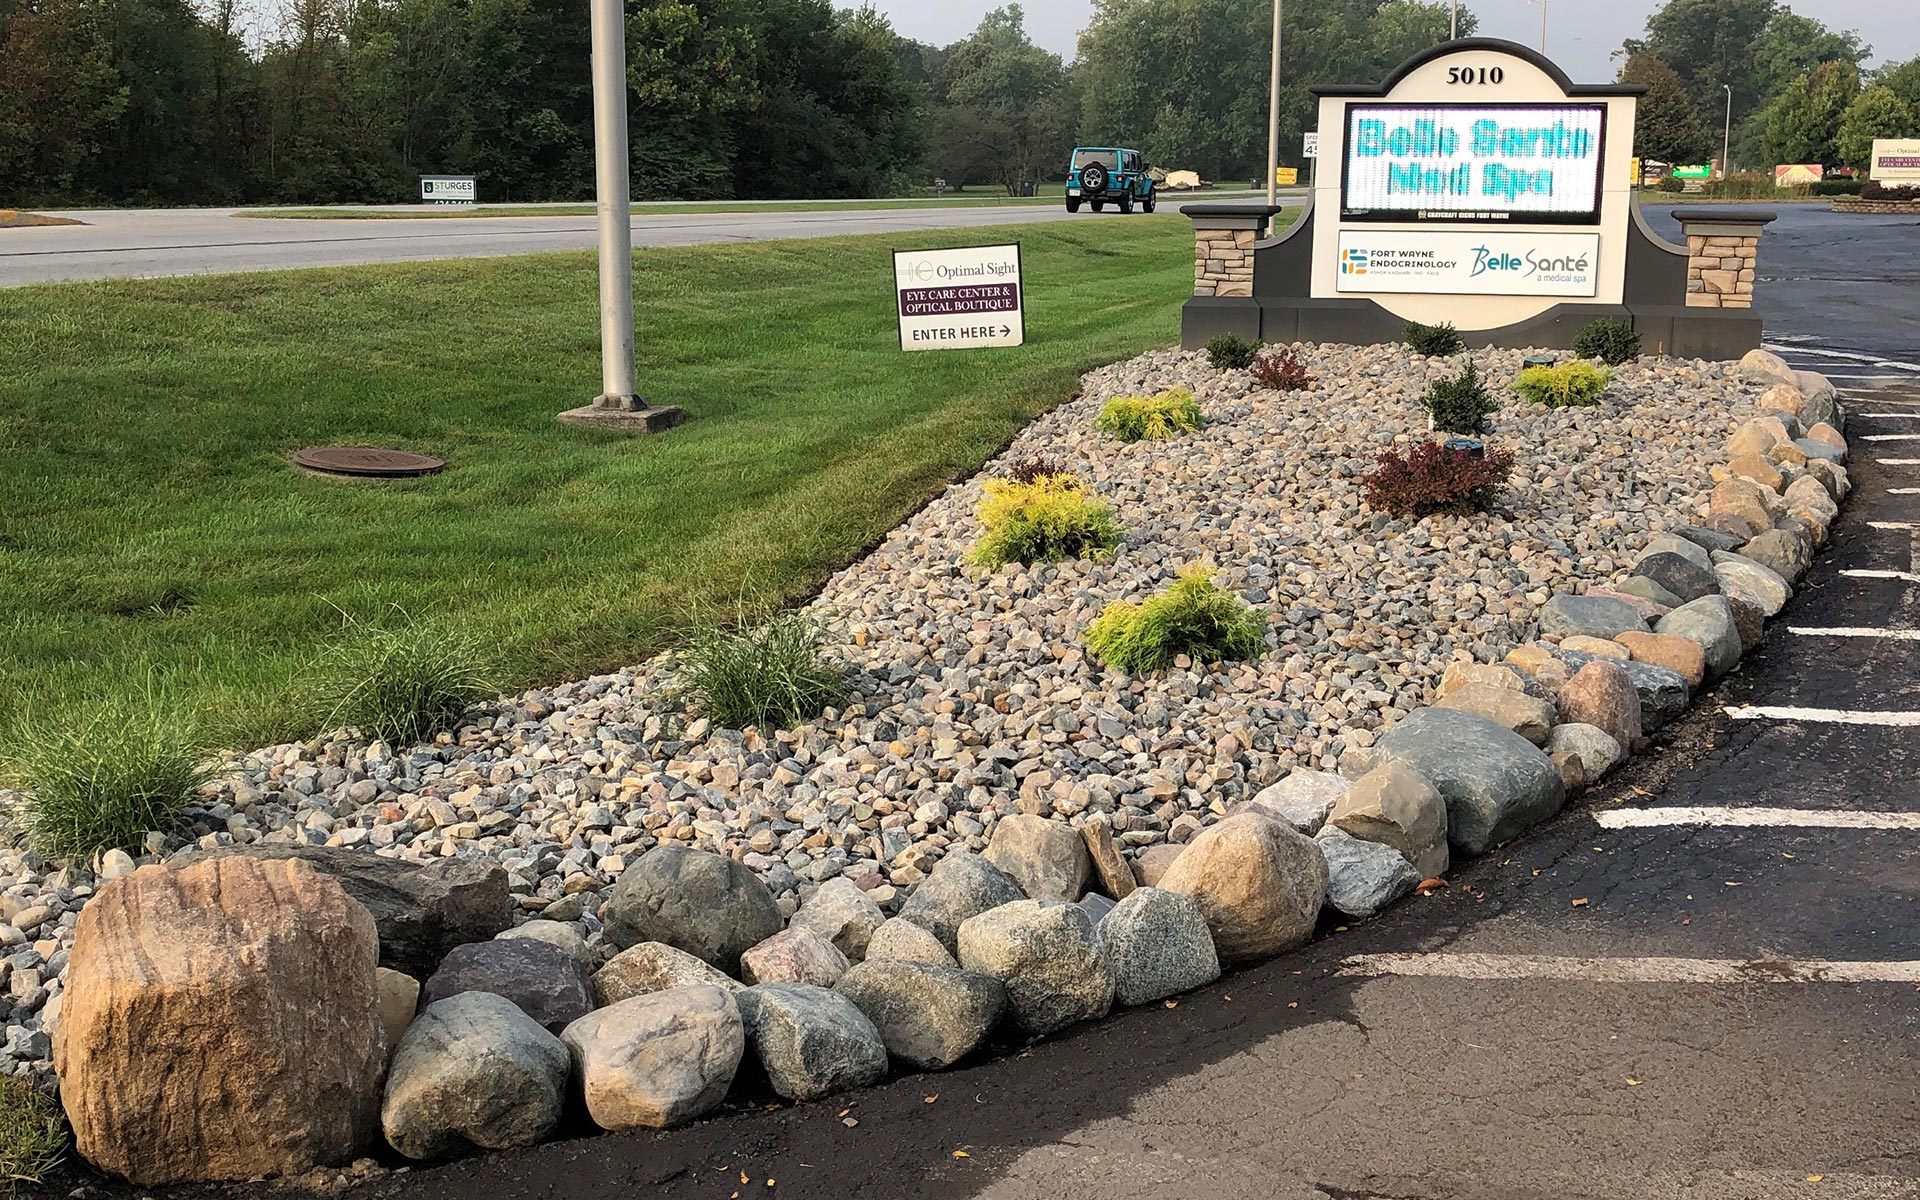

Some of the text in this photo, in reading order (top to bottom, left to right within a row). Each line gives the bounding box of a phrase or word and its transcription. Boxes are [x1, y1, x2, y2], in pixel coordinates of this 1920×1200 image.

[1446, 66, 1504, 84] 5010
[1357, 118, 1460, 158] Belle
[434, 181, 473, 190] STURGES
[1482, 162, 1553, 203] Spa
[1370, 249, 1435, 258] FORT WAYNE
[1468, 244, 1588, 278] Belle Santé
[936, 261, 1017, 280] Optimal Sight
[1370, 259, 1457, 269] ENDOCRINOLOGY
[1543, 273, 1572, 283] medical
[1573, 275, 1587, 284] spa
[906, 286, 1011, 301] EYE CARE CENTER &
[906, 298, 1013, 313] OPTICAL BOUTIQUE
[912, 326, 996, 341] ENTER HERE
